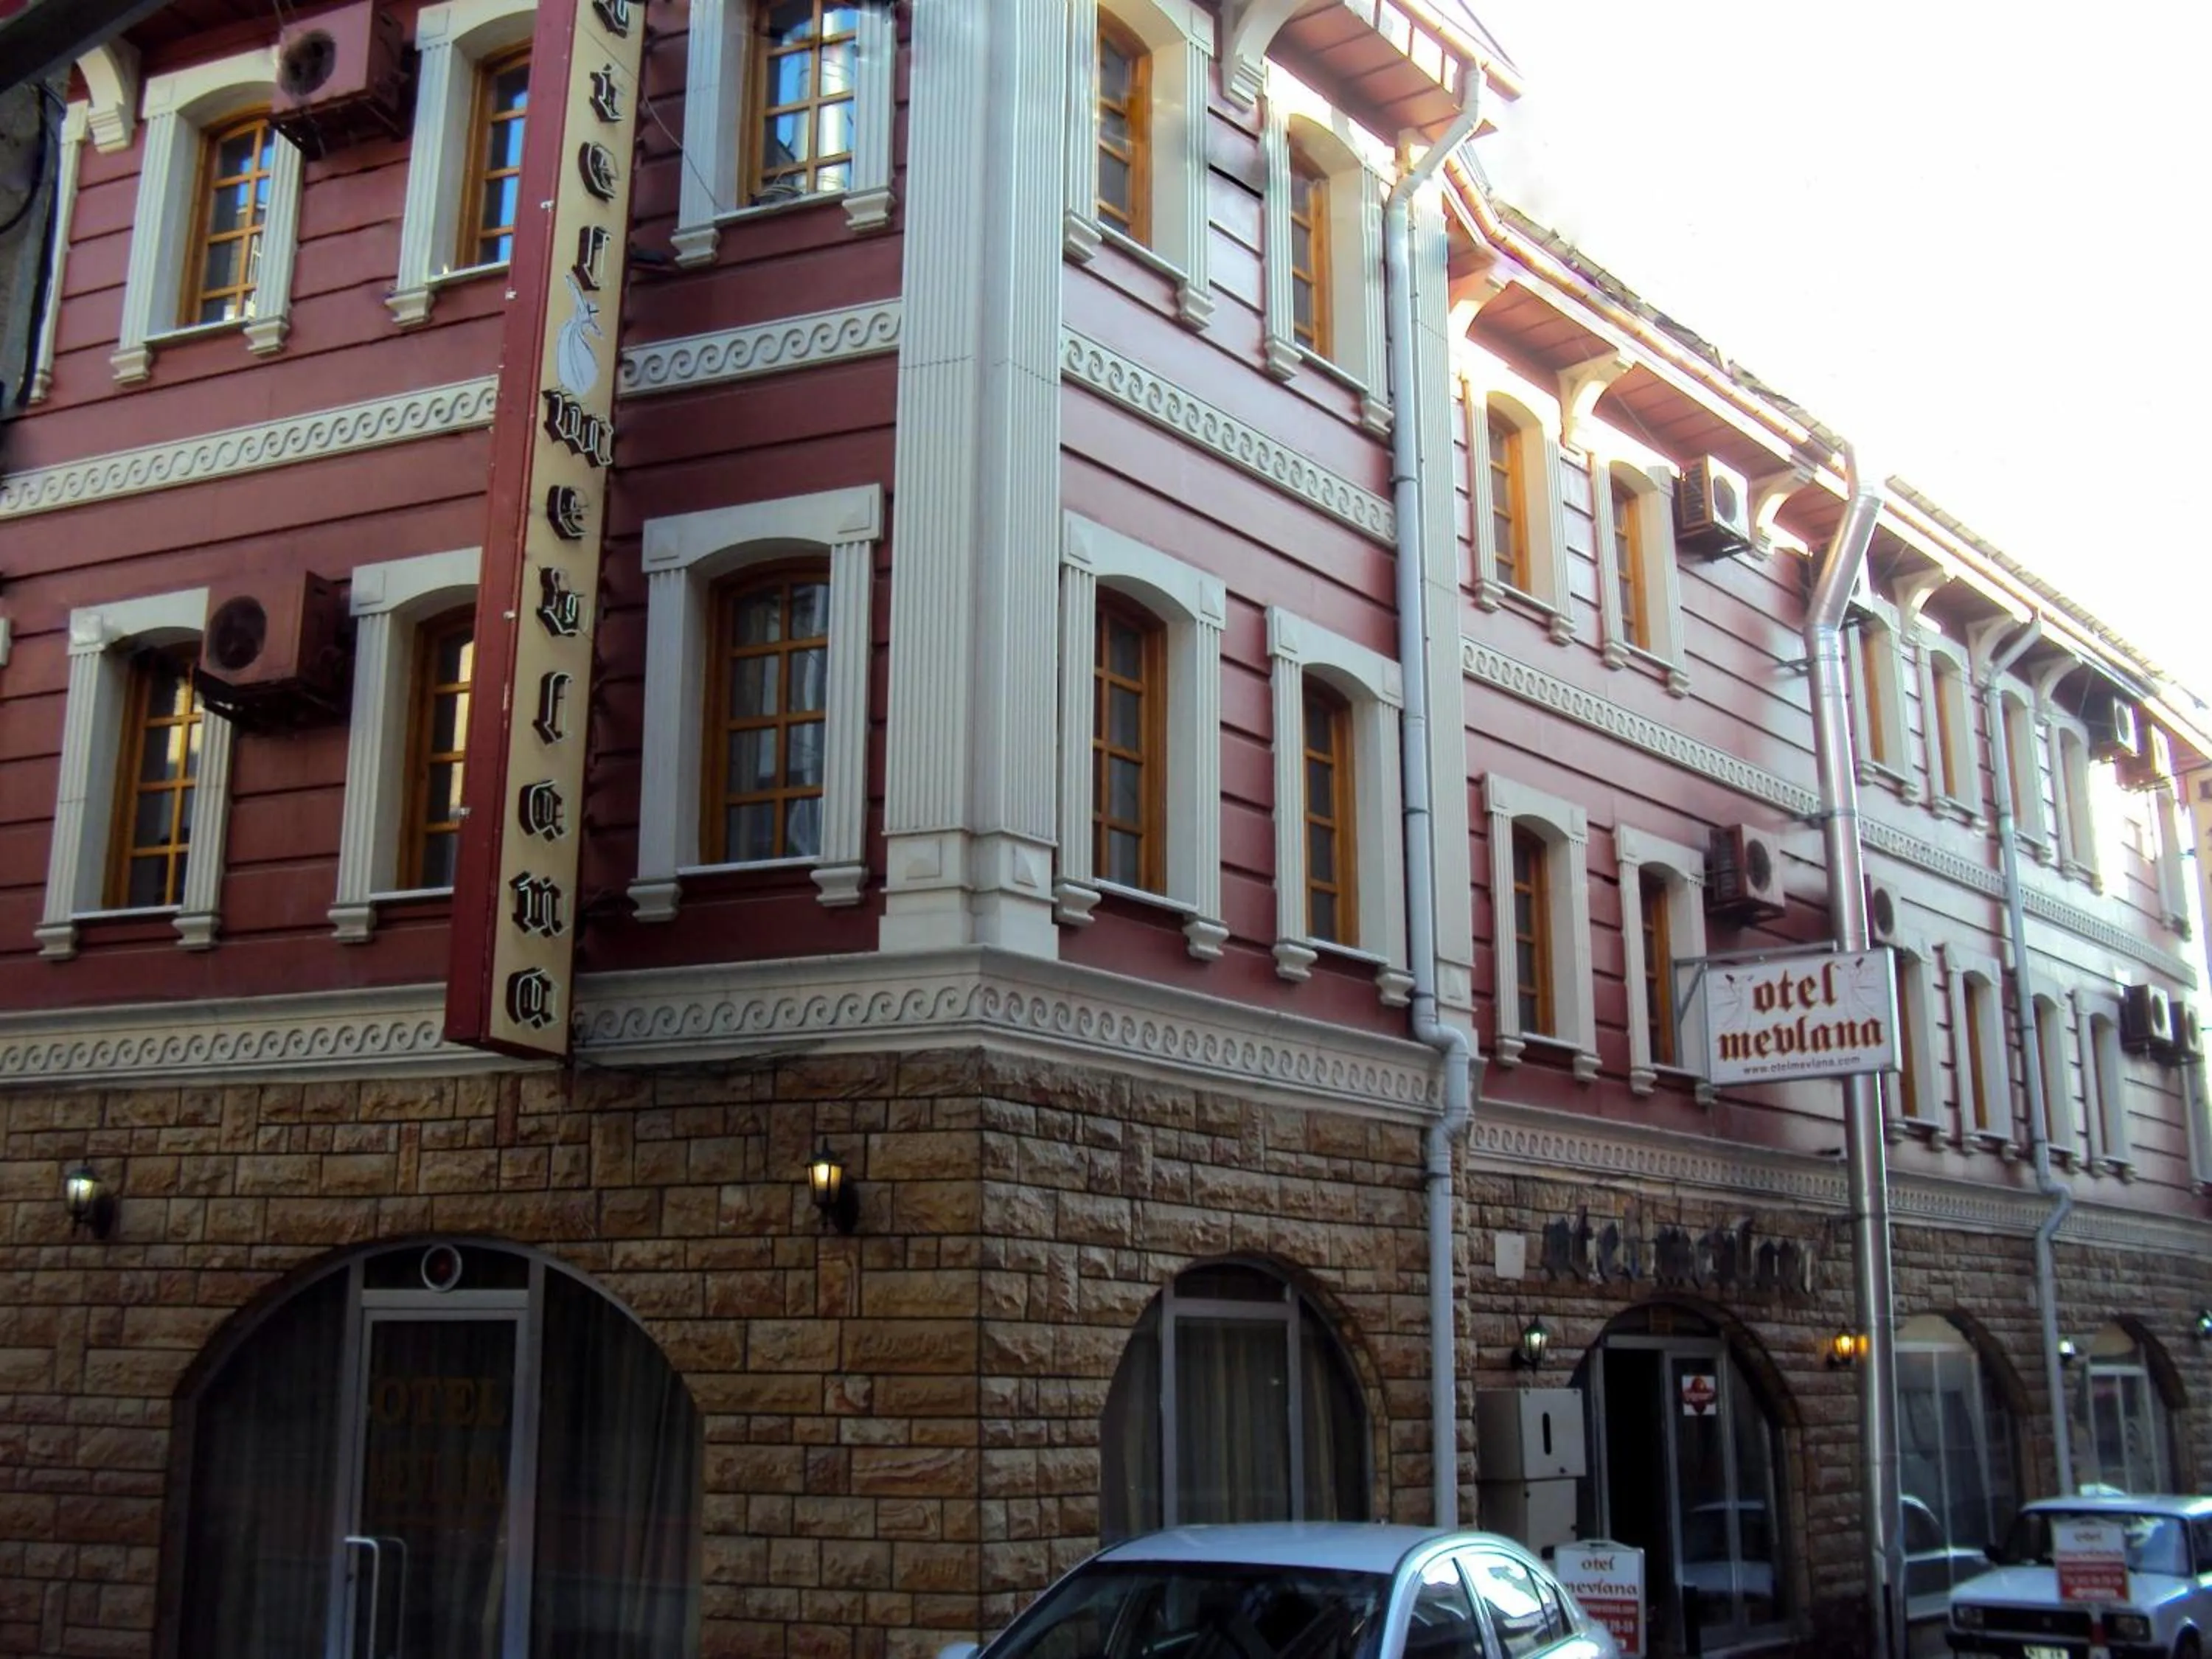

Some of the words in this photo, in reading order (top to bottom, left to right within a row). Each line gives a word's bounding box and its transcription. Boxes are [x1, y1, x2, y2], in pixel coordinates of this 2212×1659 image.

[506, 389, 613, 1030] mevlana
[1752, 961, 1838, 1015] otel
[1718, 1015, 1885, 1062] mevlana
[1581, 1556, 1615, 1571] otel
